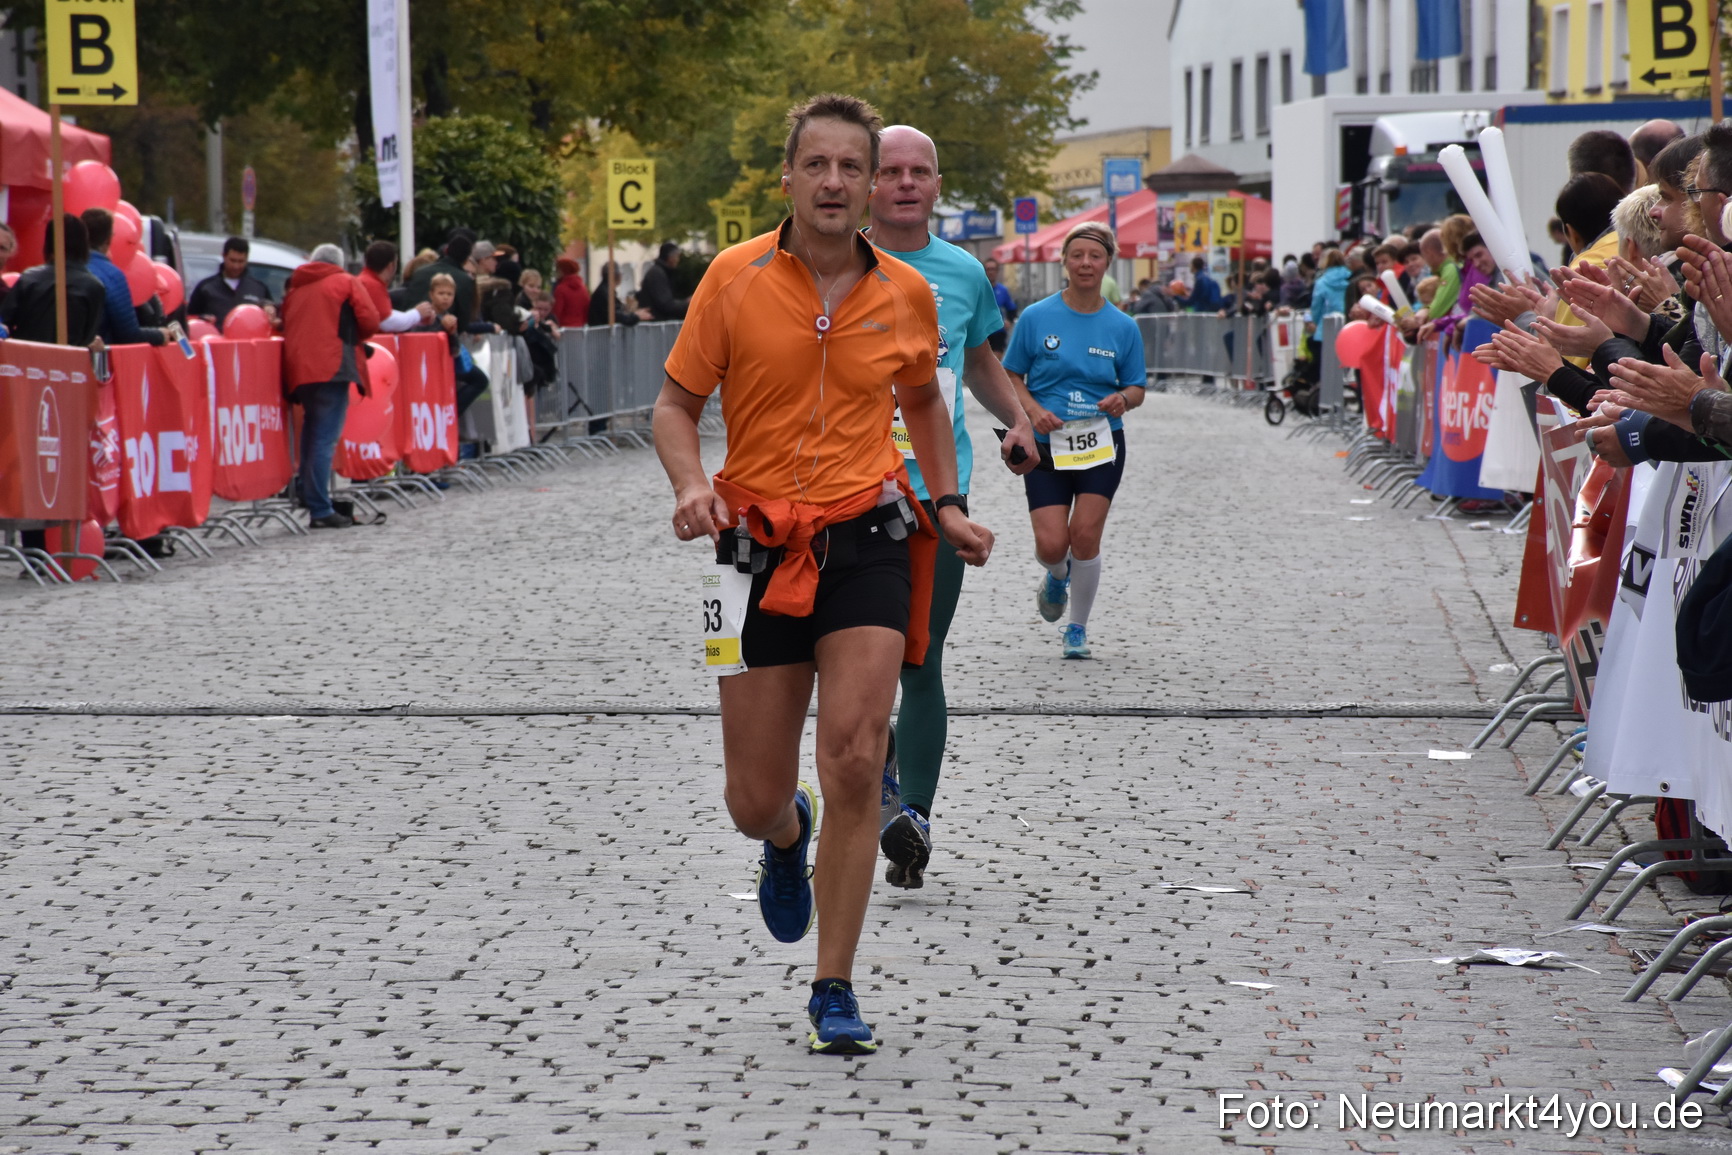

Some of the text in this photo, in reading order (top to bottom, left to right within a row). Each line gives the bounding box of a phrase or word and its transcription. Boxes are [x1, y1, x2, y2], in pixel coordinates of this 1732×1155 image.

[1652, 0, 1697, 60] B
[70, 13, 115, 75] B
[613, 163, 648, 175] Block
[620, 180, 642, 213] C
[726, 221, 742, 243] D
[1221, 212, 1238, 236] D
[1088, 347, 1115, 358] BOCK
[1068, 391, 1085, 403] 18.
[1065, 431, 1098, 452] 158
[1072, 453, 1096, 462] Christa
[703, 599, 722, 633] 63
